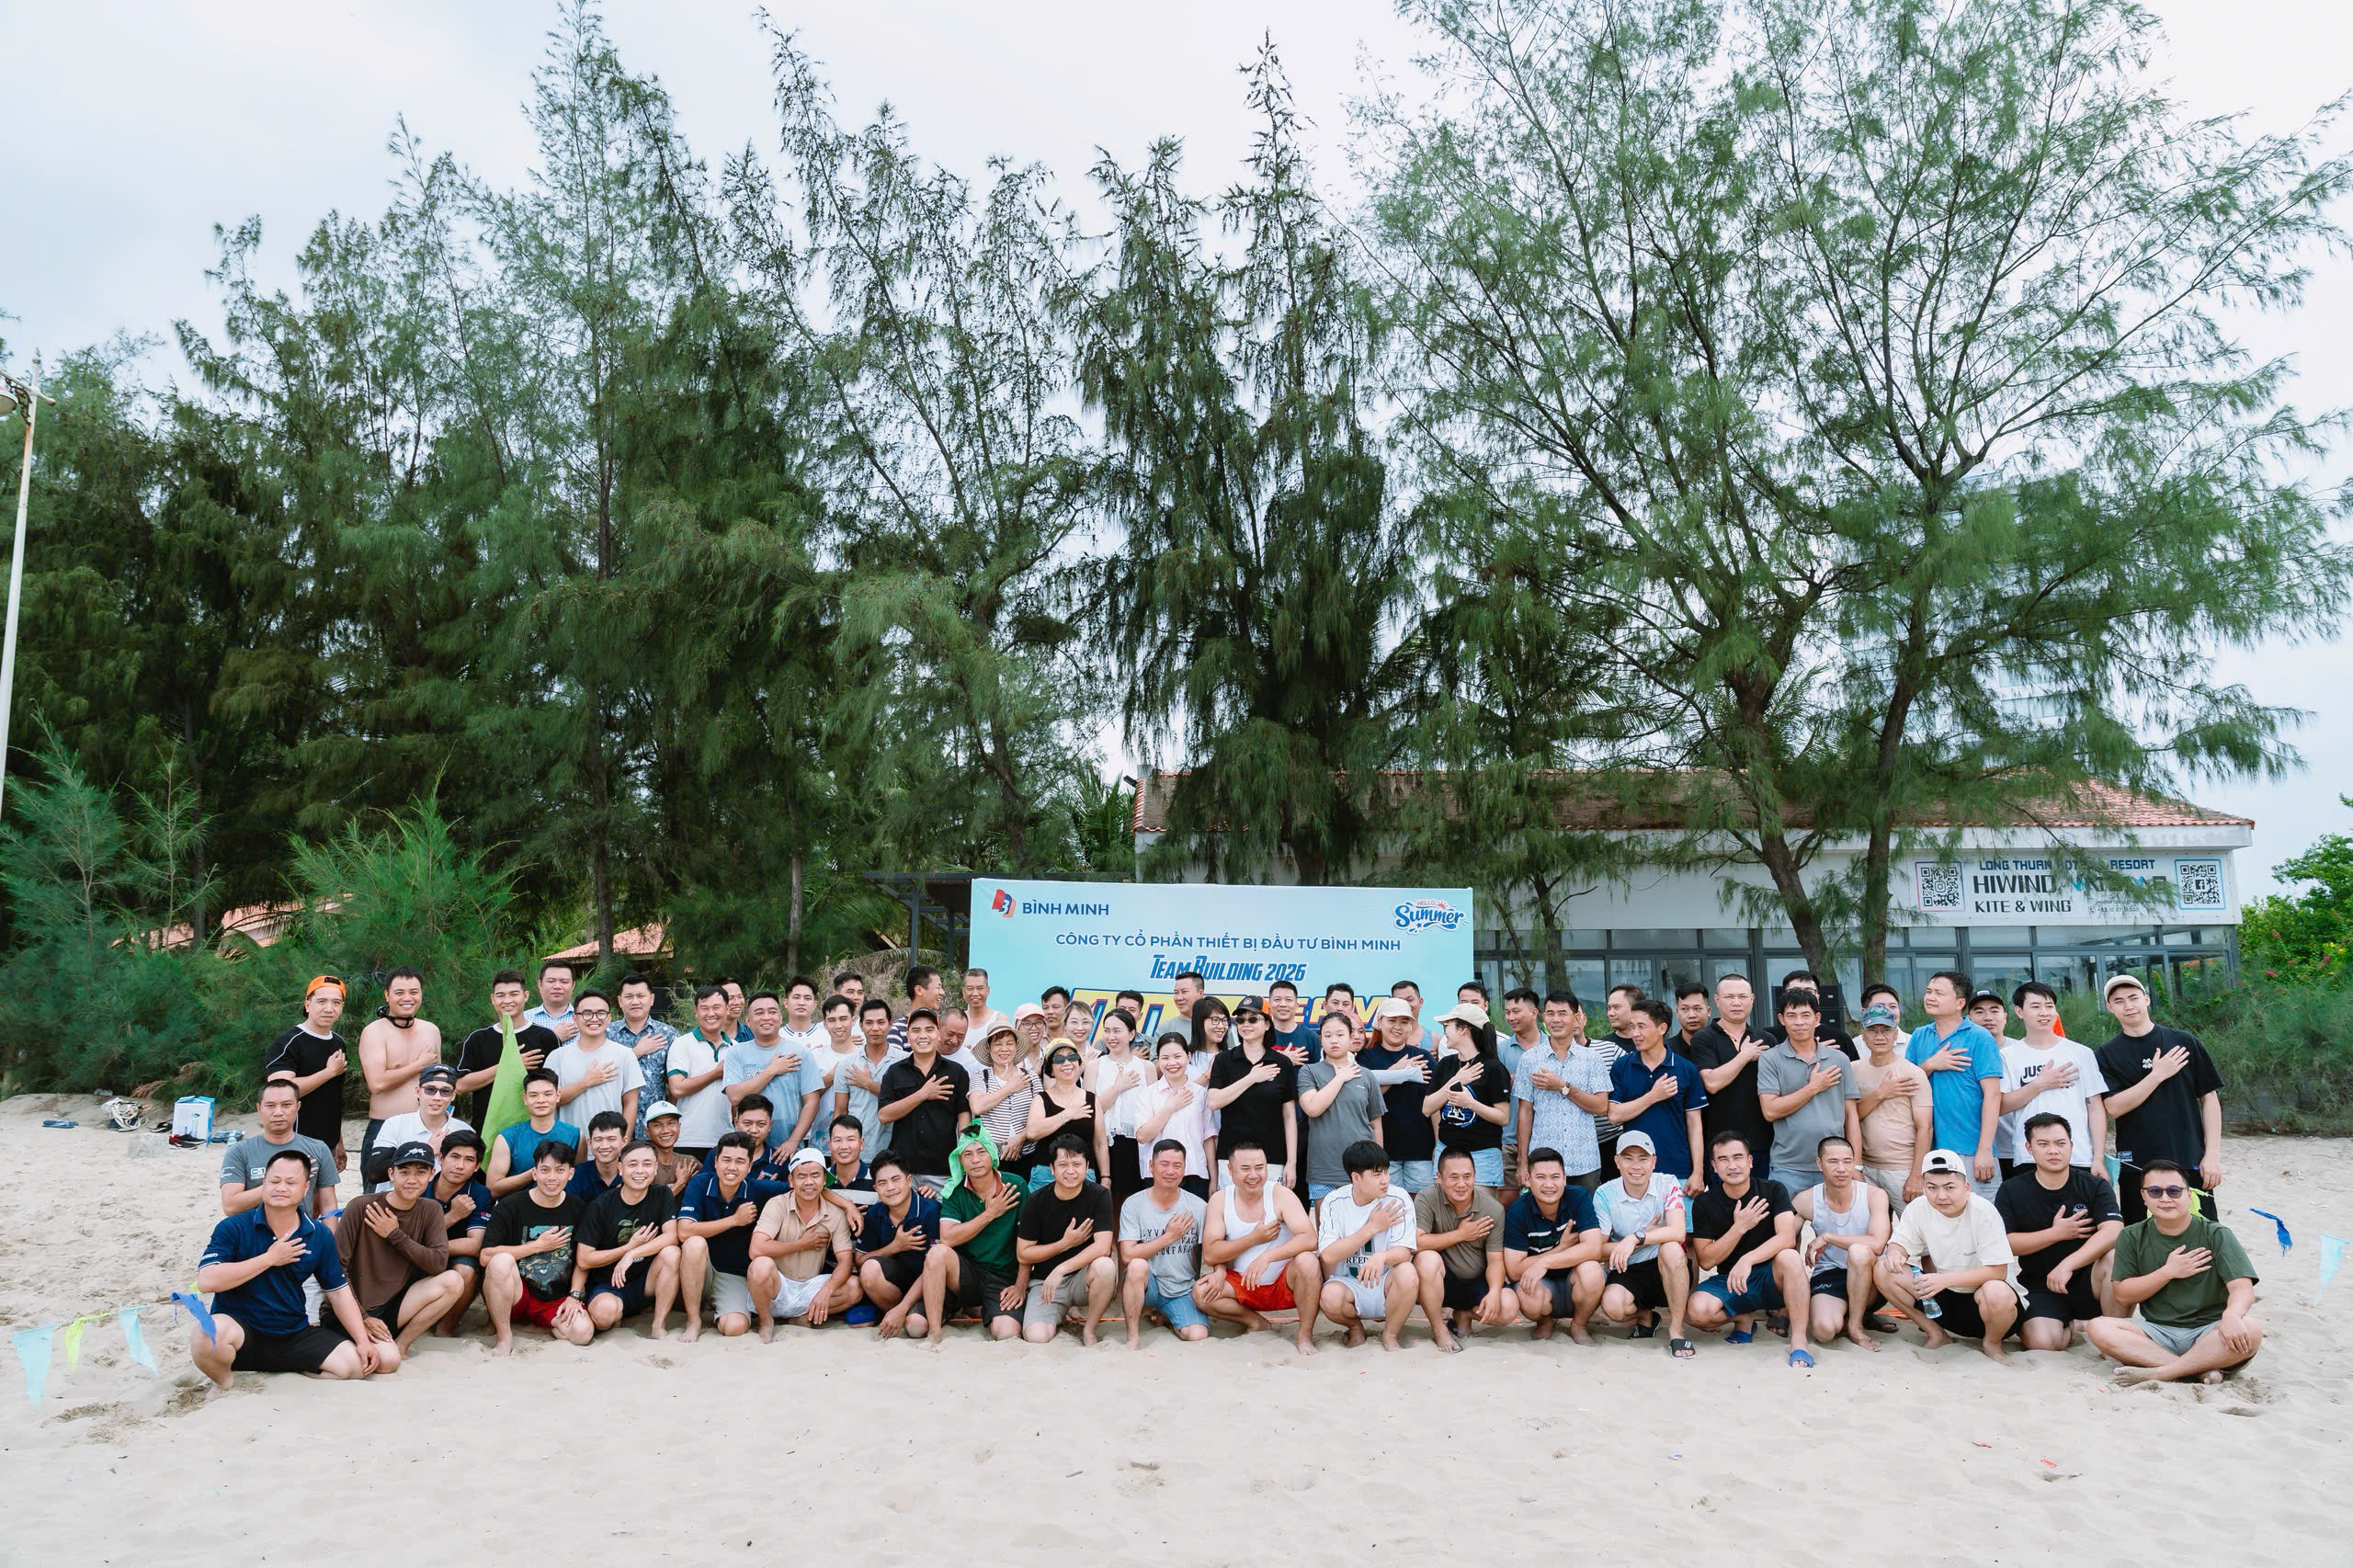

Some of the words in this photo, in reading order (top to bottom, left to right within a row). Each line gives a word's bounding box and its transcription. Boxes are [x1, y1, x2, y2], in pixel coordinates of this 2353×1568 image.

[1979, 859, 2010, 871] LONG
[2110, 858, 2155, 870] RESORT
[1972, 874, 2057, 894] HIWIND
[1022, 899, 1062, 915] BÌNH
[1065, 903, 1109, 915] MINH
[1974, 900, 2011, 913] KITE
[2015, 900, 2026, 913] &
[2029, 899, 2072, 913] WING
[1394, 904, 1464, 928] Summer
[1055, 932, 1099, 946] CÔNG
[1102, 935, 1122, 946] TY
[1124, 929, 1146, 947] CỔ
[1150, 931, 1193, 948] PHẦN
[1196, 932, 1240, 949] THIẾT
[1243, 937, 1257, 951] BỊ
[1261, 933, 1294, 949] ĐẦU
[1297, 937, 1319, 949] TƯ
[1321, 937, 1358, 950] BÌNH
[1361, 939, 1401, 951] MINH
[1150, 954, 1192, 979] TEAM
[1195, 955, 1263, 981] BUILDING
[1264, 963, 1307, 981] 2026
[2023, 1064, 2046, 1079] JUS
